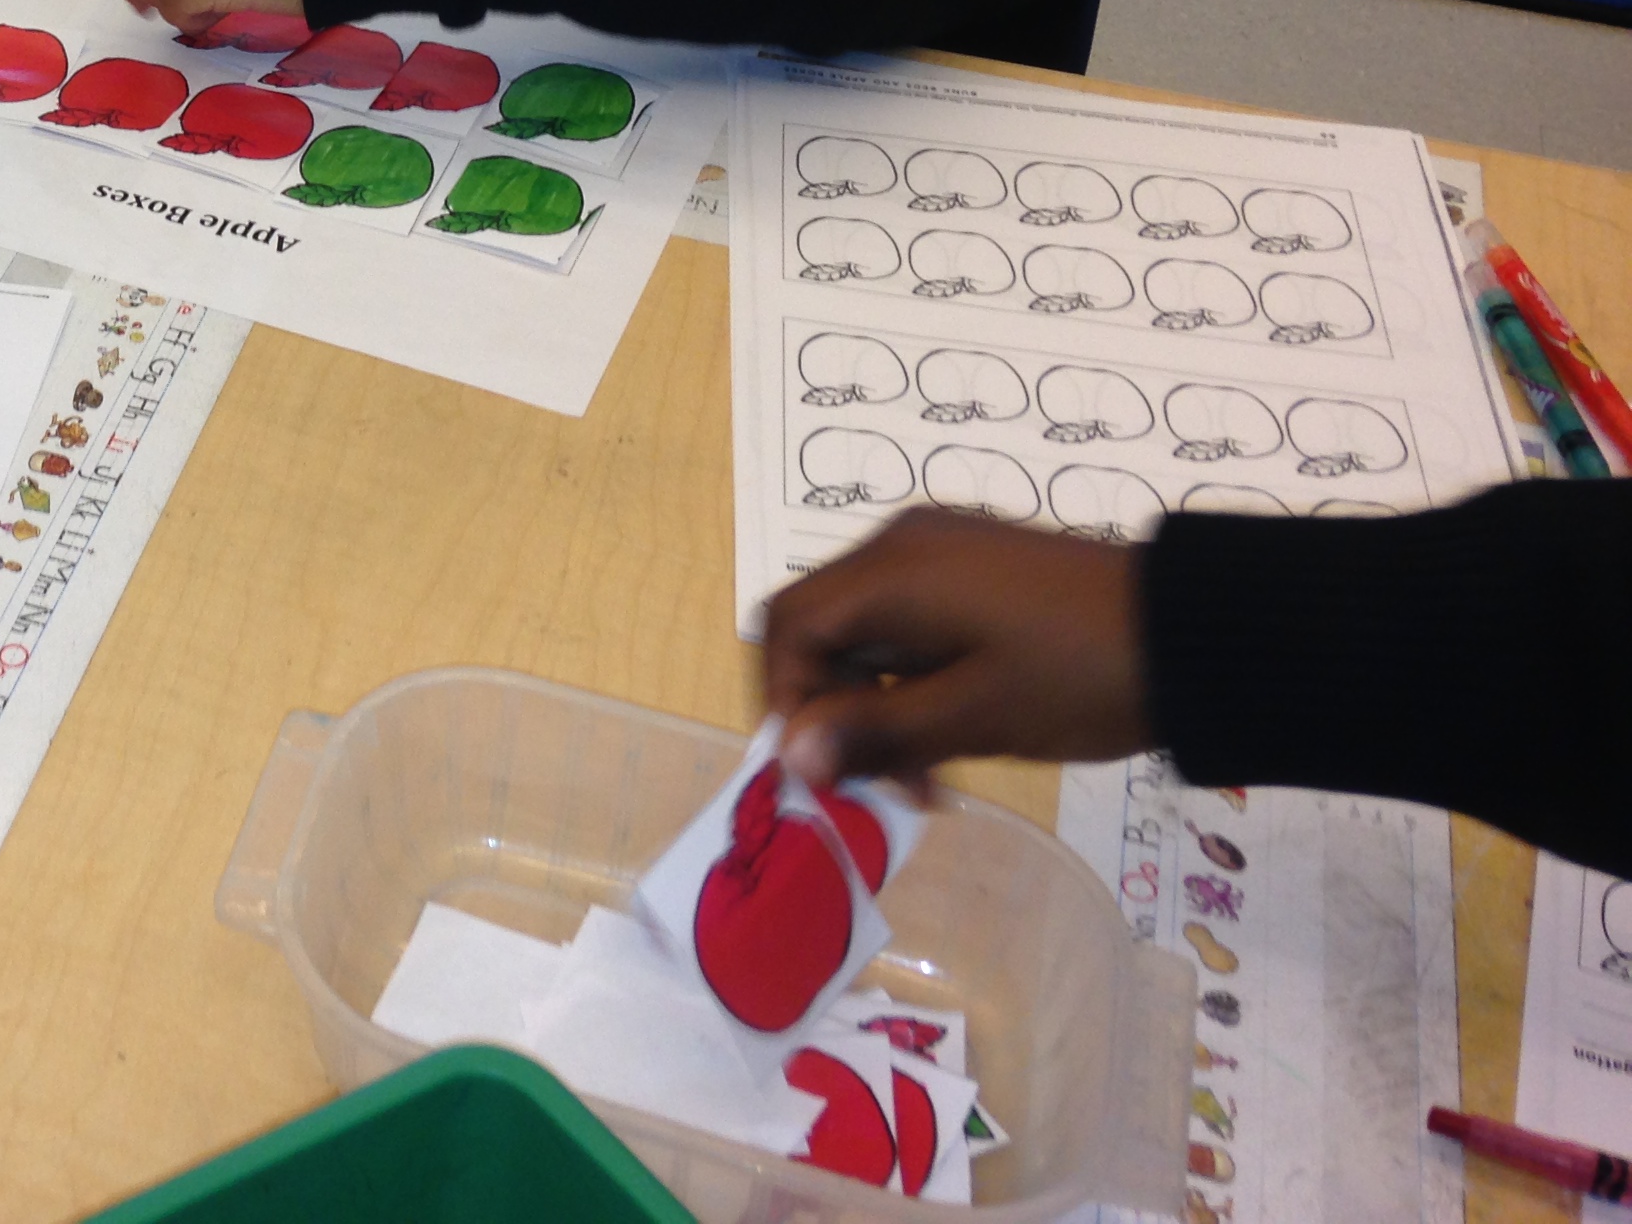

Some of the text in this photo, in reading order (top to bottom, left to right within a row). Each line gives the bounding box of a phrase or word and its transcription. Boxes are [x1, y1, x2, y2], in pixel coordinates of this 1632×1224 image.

[92, 184, 301, 253] Apple Boxes
[131, 357, 177, 385] Gg
[122, 395, 160, 420] Hh
[71, 495, 108, 520] Kk
[31, 555, 77, 595] Mm
[11, 602, 54, 634] Nn
